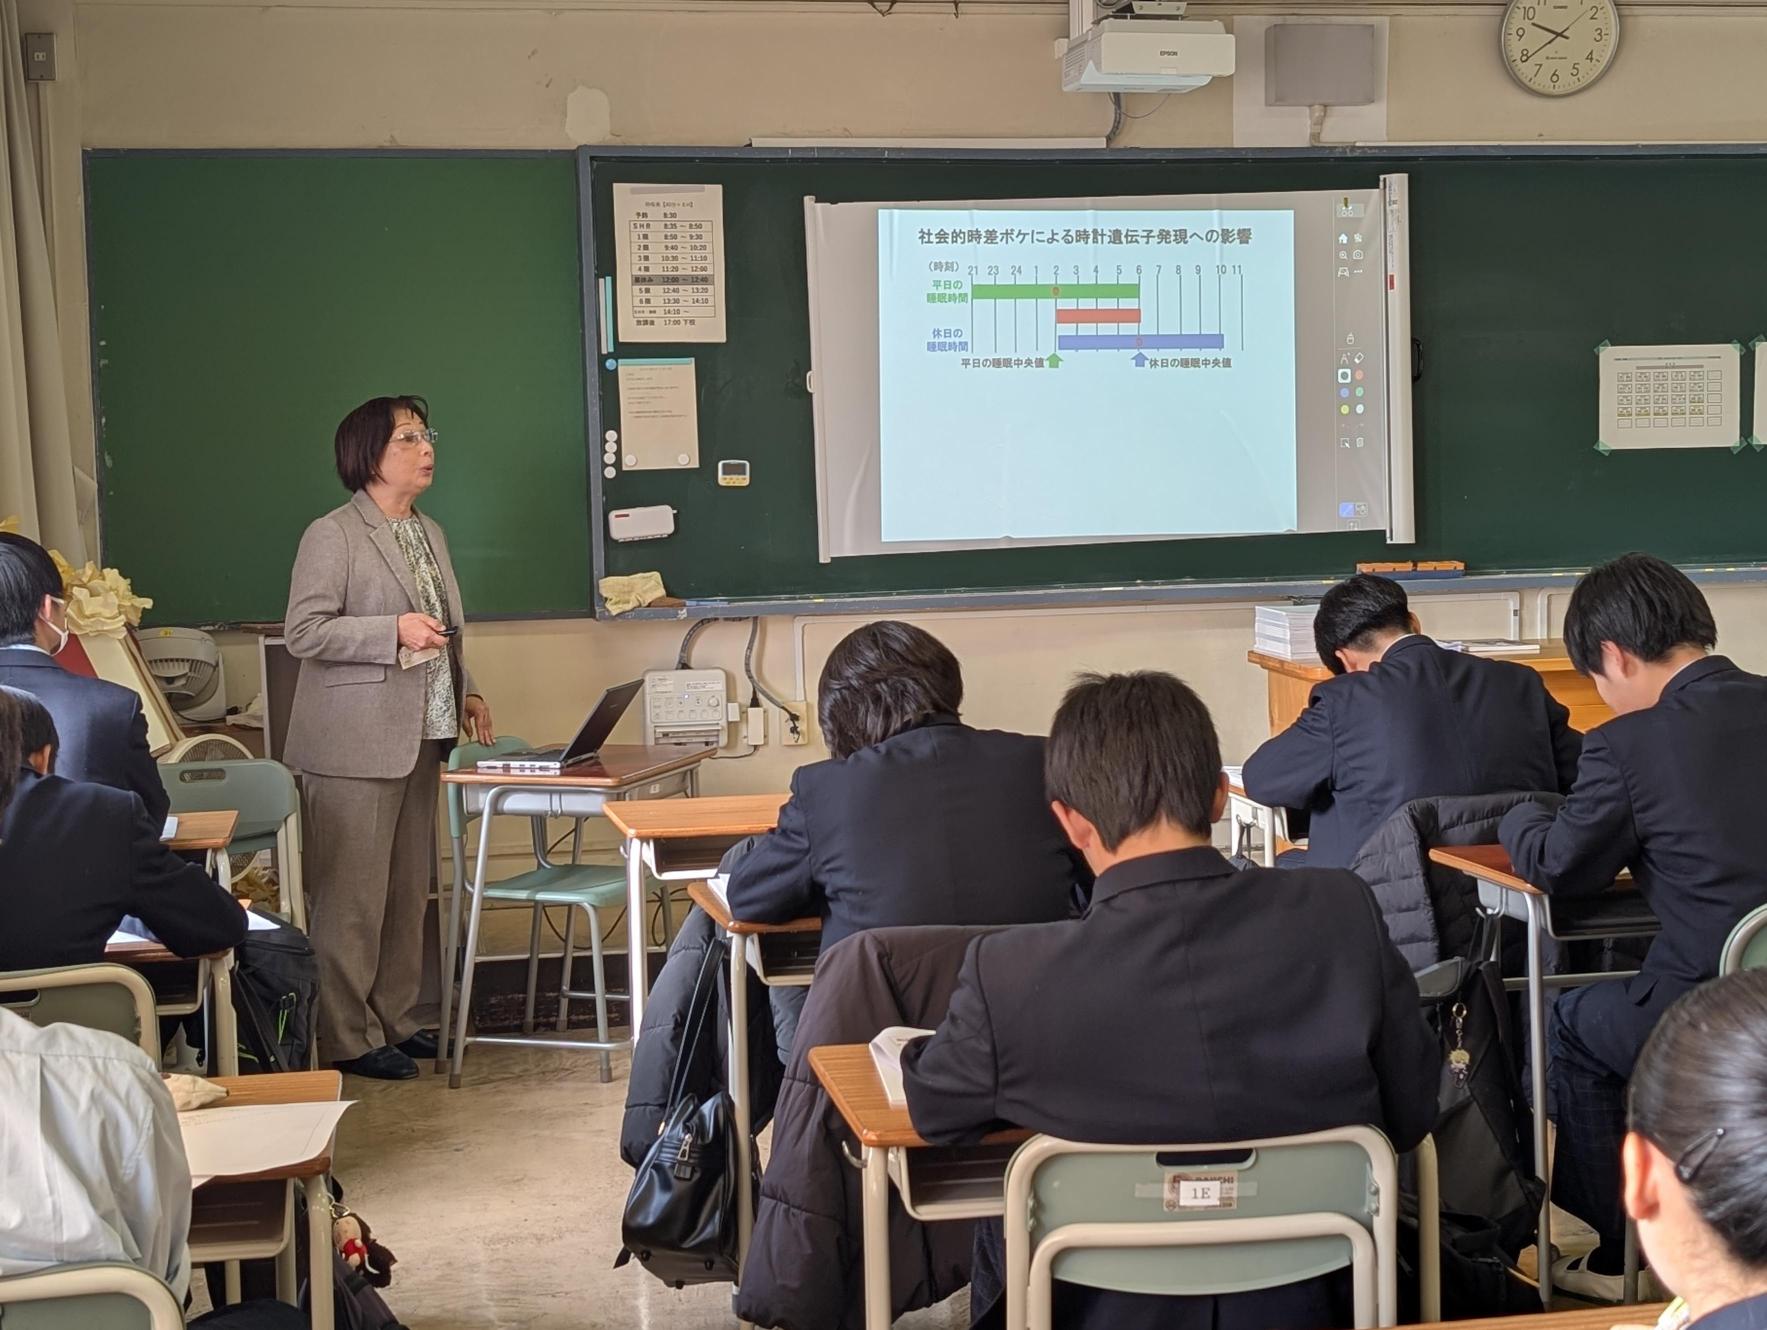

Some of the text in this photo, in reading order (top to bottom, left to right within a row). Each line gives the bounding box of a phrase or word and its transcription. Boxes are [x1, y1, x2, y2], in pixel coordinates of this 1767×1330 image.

[1522, 6, 1536, 21] 10
[1590, 5, 1599, 20] 2
[1516, 27, 1526, 41] 9
[1593, 27, 1603, 42] 3
[1520, 48, 1530, 63] 8
[1585, 49, 1594, 63] 4
[1534, 63, 1543, 77] 7
[1550, 69, 1560, 83] 6
[1570, 63, 1580, 77] 5
[918, 228, 1253, 245] 社会的時差ボケによる時計遺伝子発現への影響
[968, 265, 979, 275] 21
[988, 265, 1000, 275] 23
[1011, 265, 1023, 275] 24
[1053, 265, 1060, 275] 2
[1073, 265, 1080, 275] 3
[1093, 265, 1099, 275] 4
[1116, 265, 1122, 275] 5
[1136, 265, 1142, 275] 6
[1156, 265, 1162, 275] 7
[1175, 265, 1182, 275] 8
[1195, 265, 1201, 275] 9
[1216, 265, 1227, 275] 10
[1232, 265, 1242, 275] 11
[932, 280, 963, 290] 平日の
[926, 293, 969, 304] 睡眠時間
[932, 328, 963, 339] 休日の
[926, 341, 969, 352] 睡眠時間
[961, 357, 1045, 368] 平日の睡眠中央値
[1149, 357, 1232, 368] 休日の睡眠中央値
[1191, 1187, 1211, 1200] 1E
